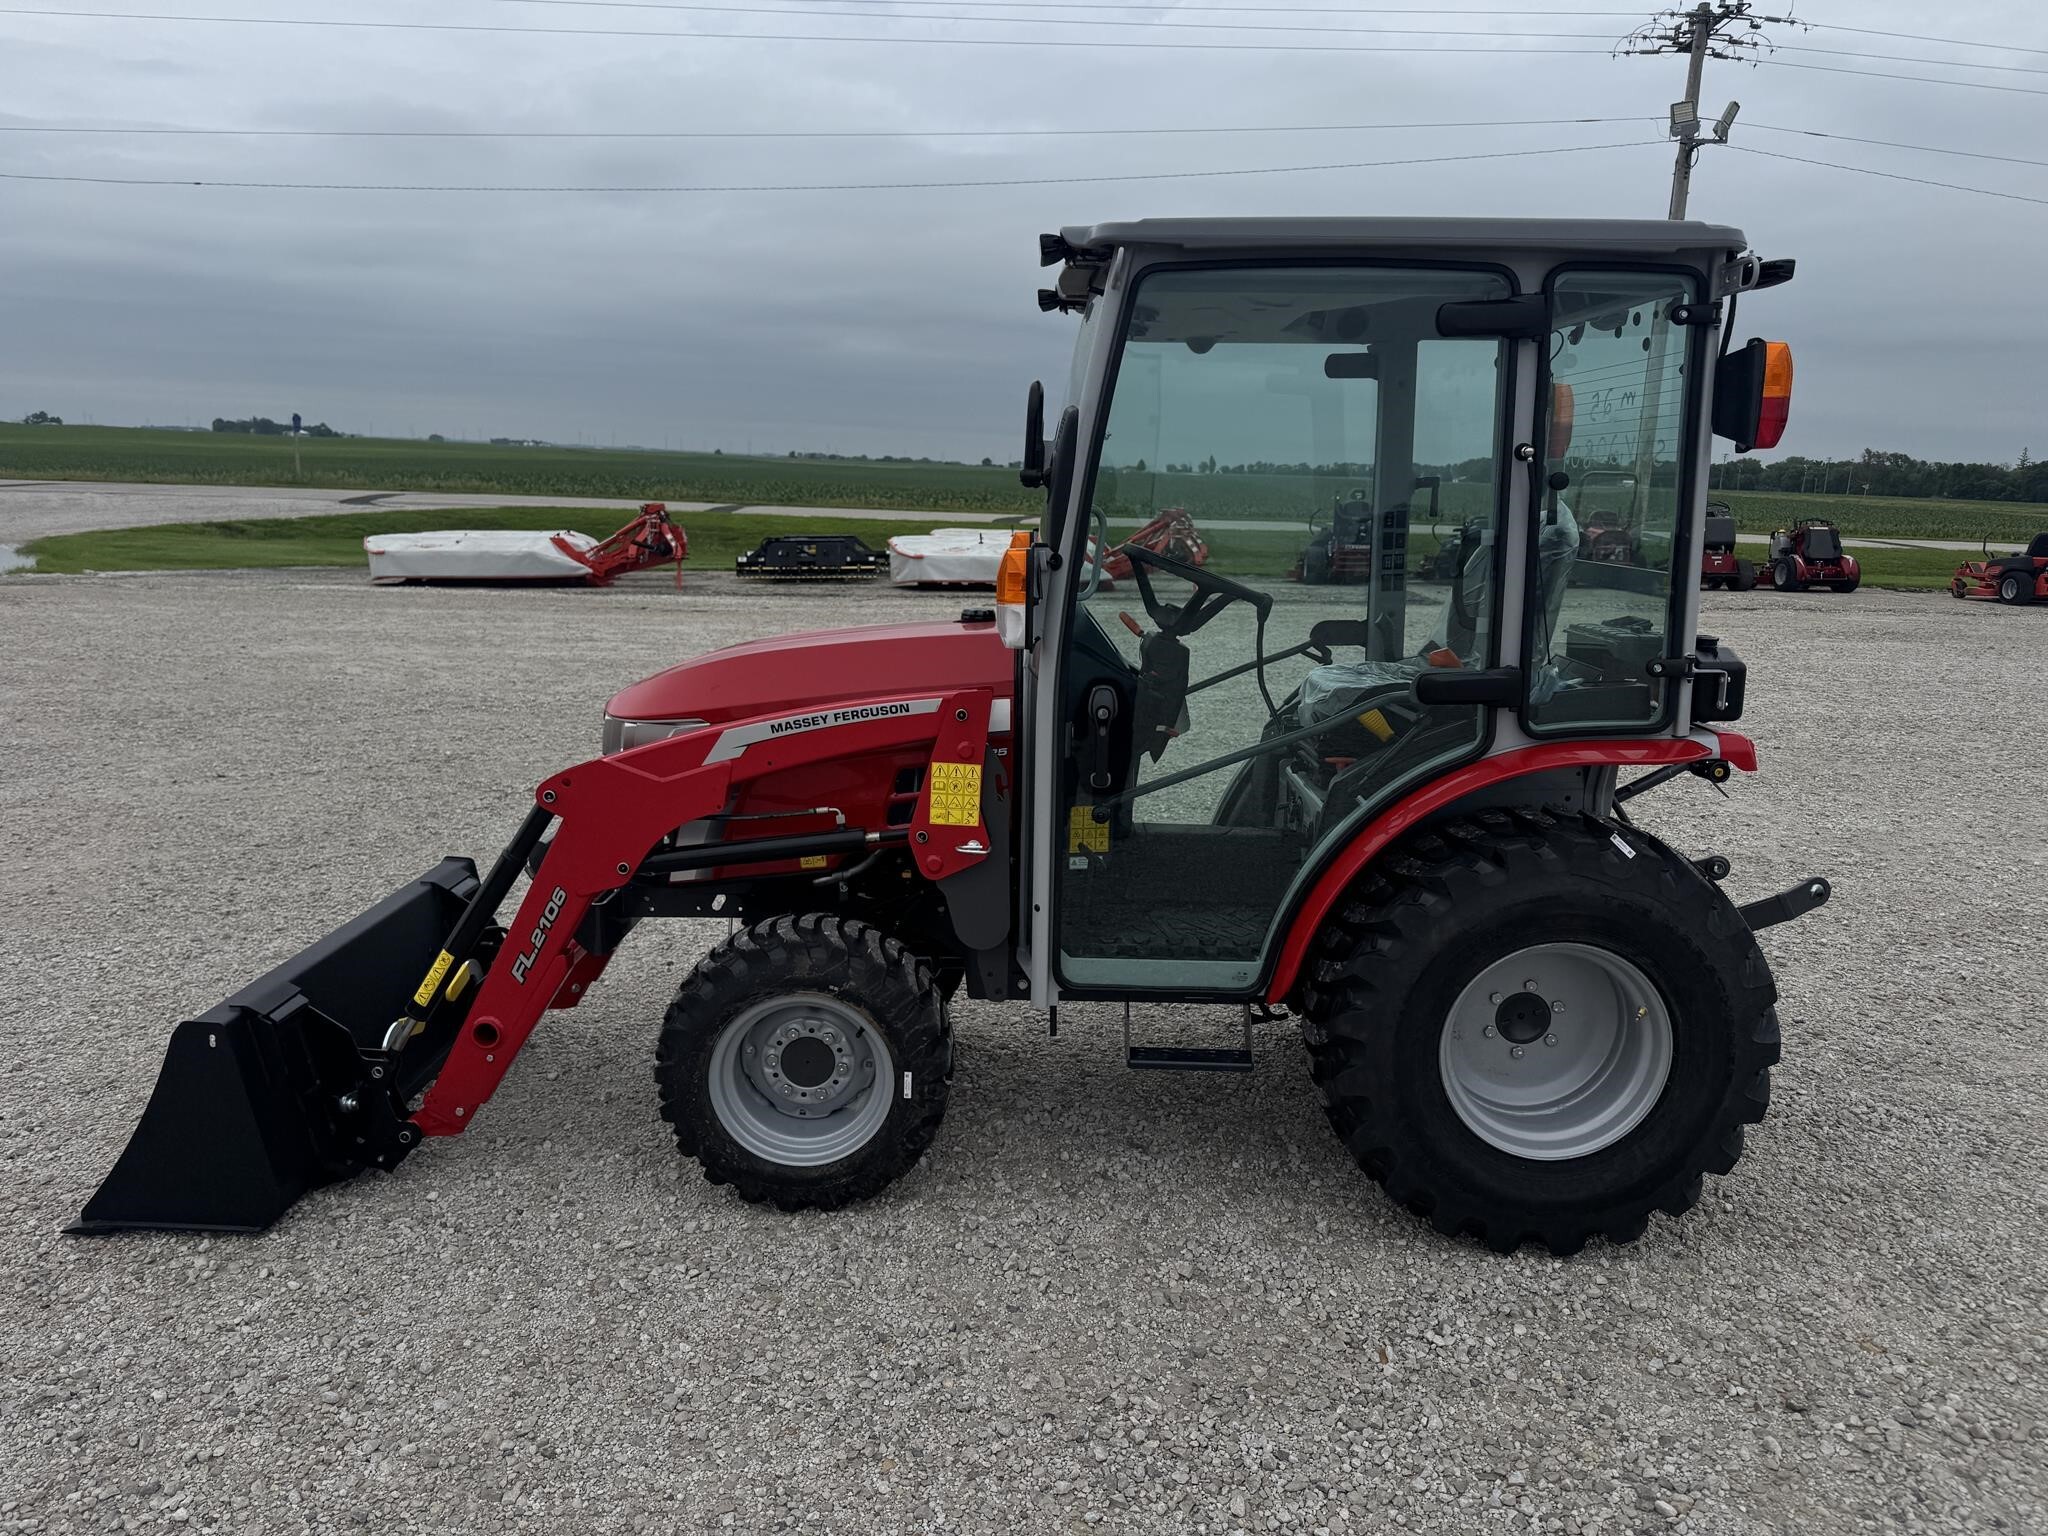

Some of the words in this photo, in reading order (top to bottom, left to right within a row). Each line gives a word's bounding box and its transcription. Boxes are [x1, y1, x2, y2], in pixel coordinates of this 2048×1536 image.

[770, 713, 829, 735] MASSEY
[833, 703, 911, 723] FERGUSON
[512, 887, 567, 984] FL.2106
